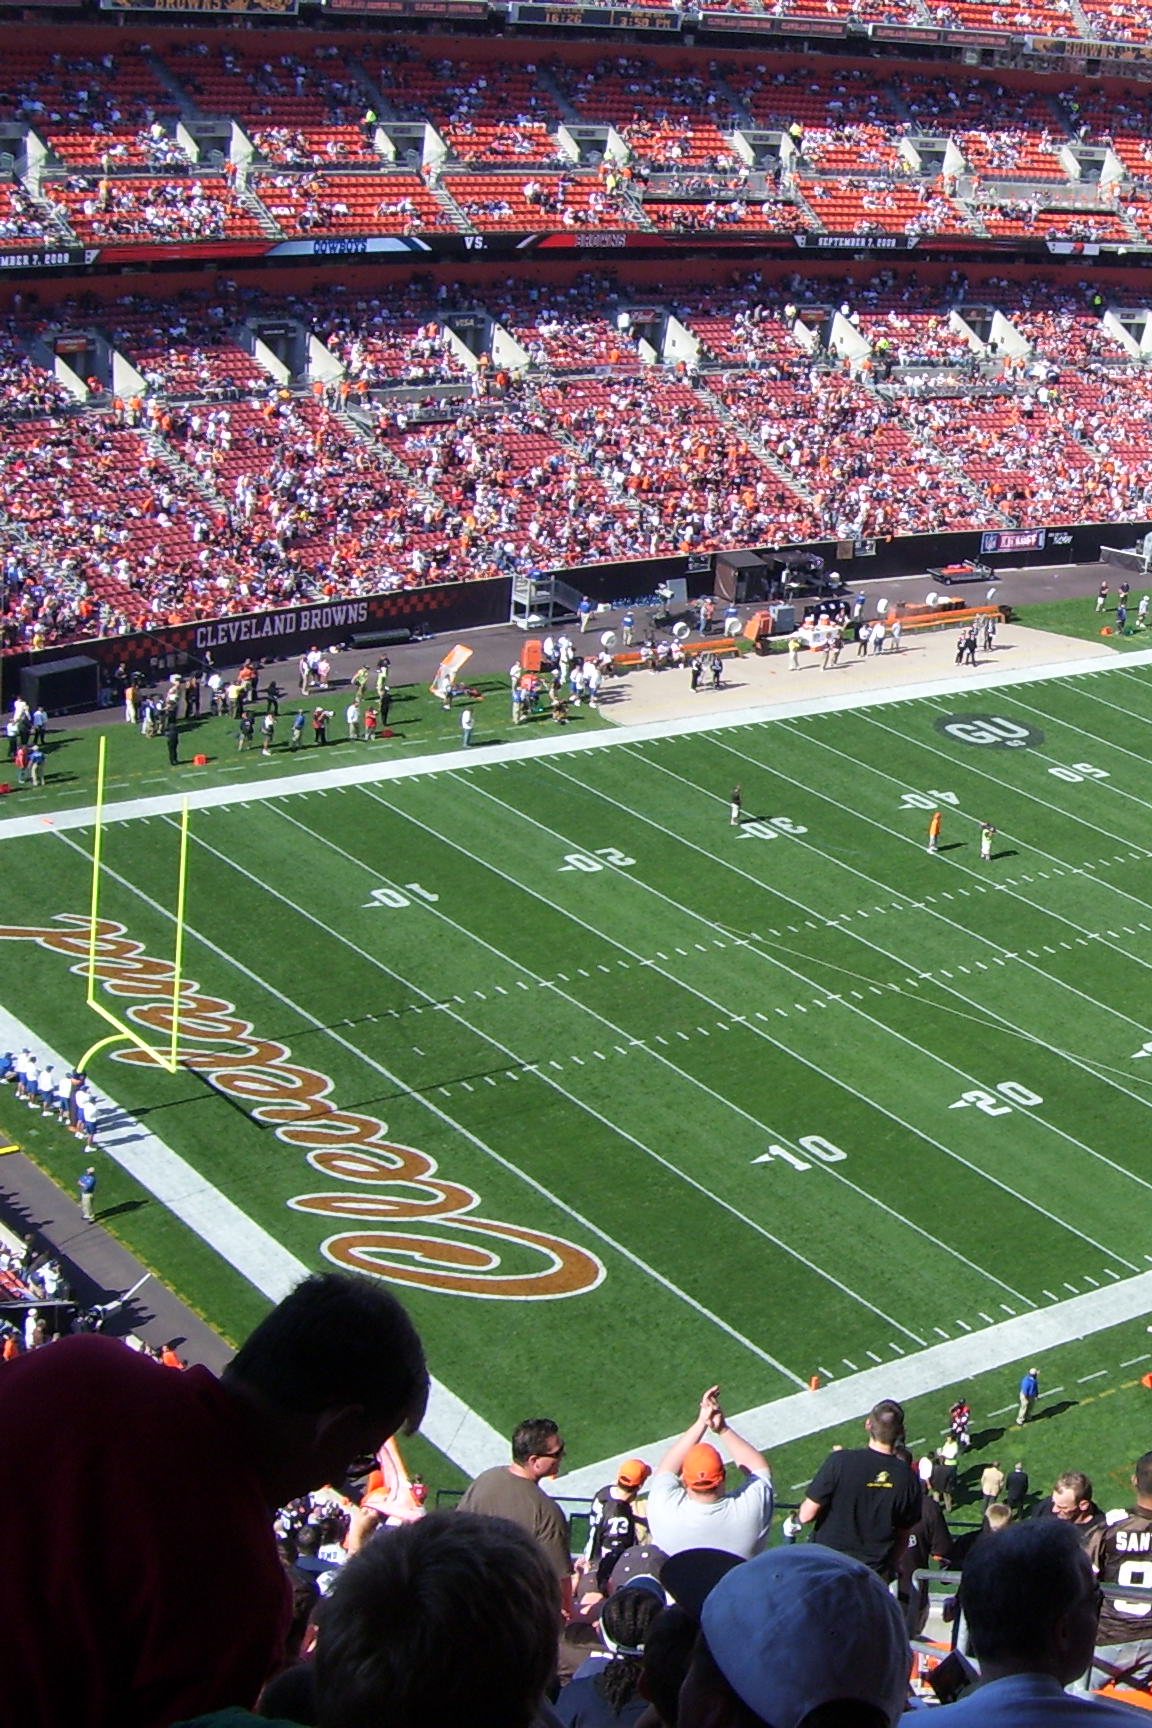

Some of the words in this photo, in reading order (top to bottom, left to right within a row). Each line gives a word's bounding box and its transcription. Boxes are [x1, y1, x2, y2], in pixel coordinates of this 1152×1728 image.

[313, 238, 368, 254] COWBOYS
[463, 236, 488, 249] VS.
[196, 612, 297, 649] CLEVELAND
[300, 602, 368, 632] BROWNS
[944, 717, 1031, 744] GU
[960, 1080, 1044, 1117] 20
[767, 1134, 848, 1172] 10
[607, 1516, 630, 1535] 73
